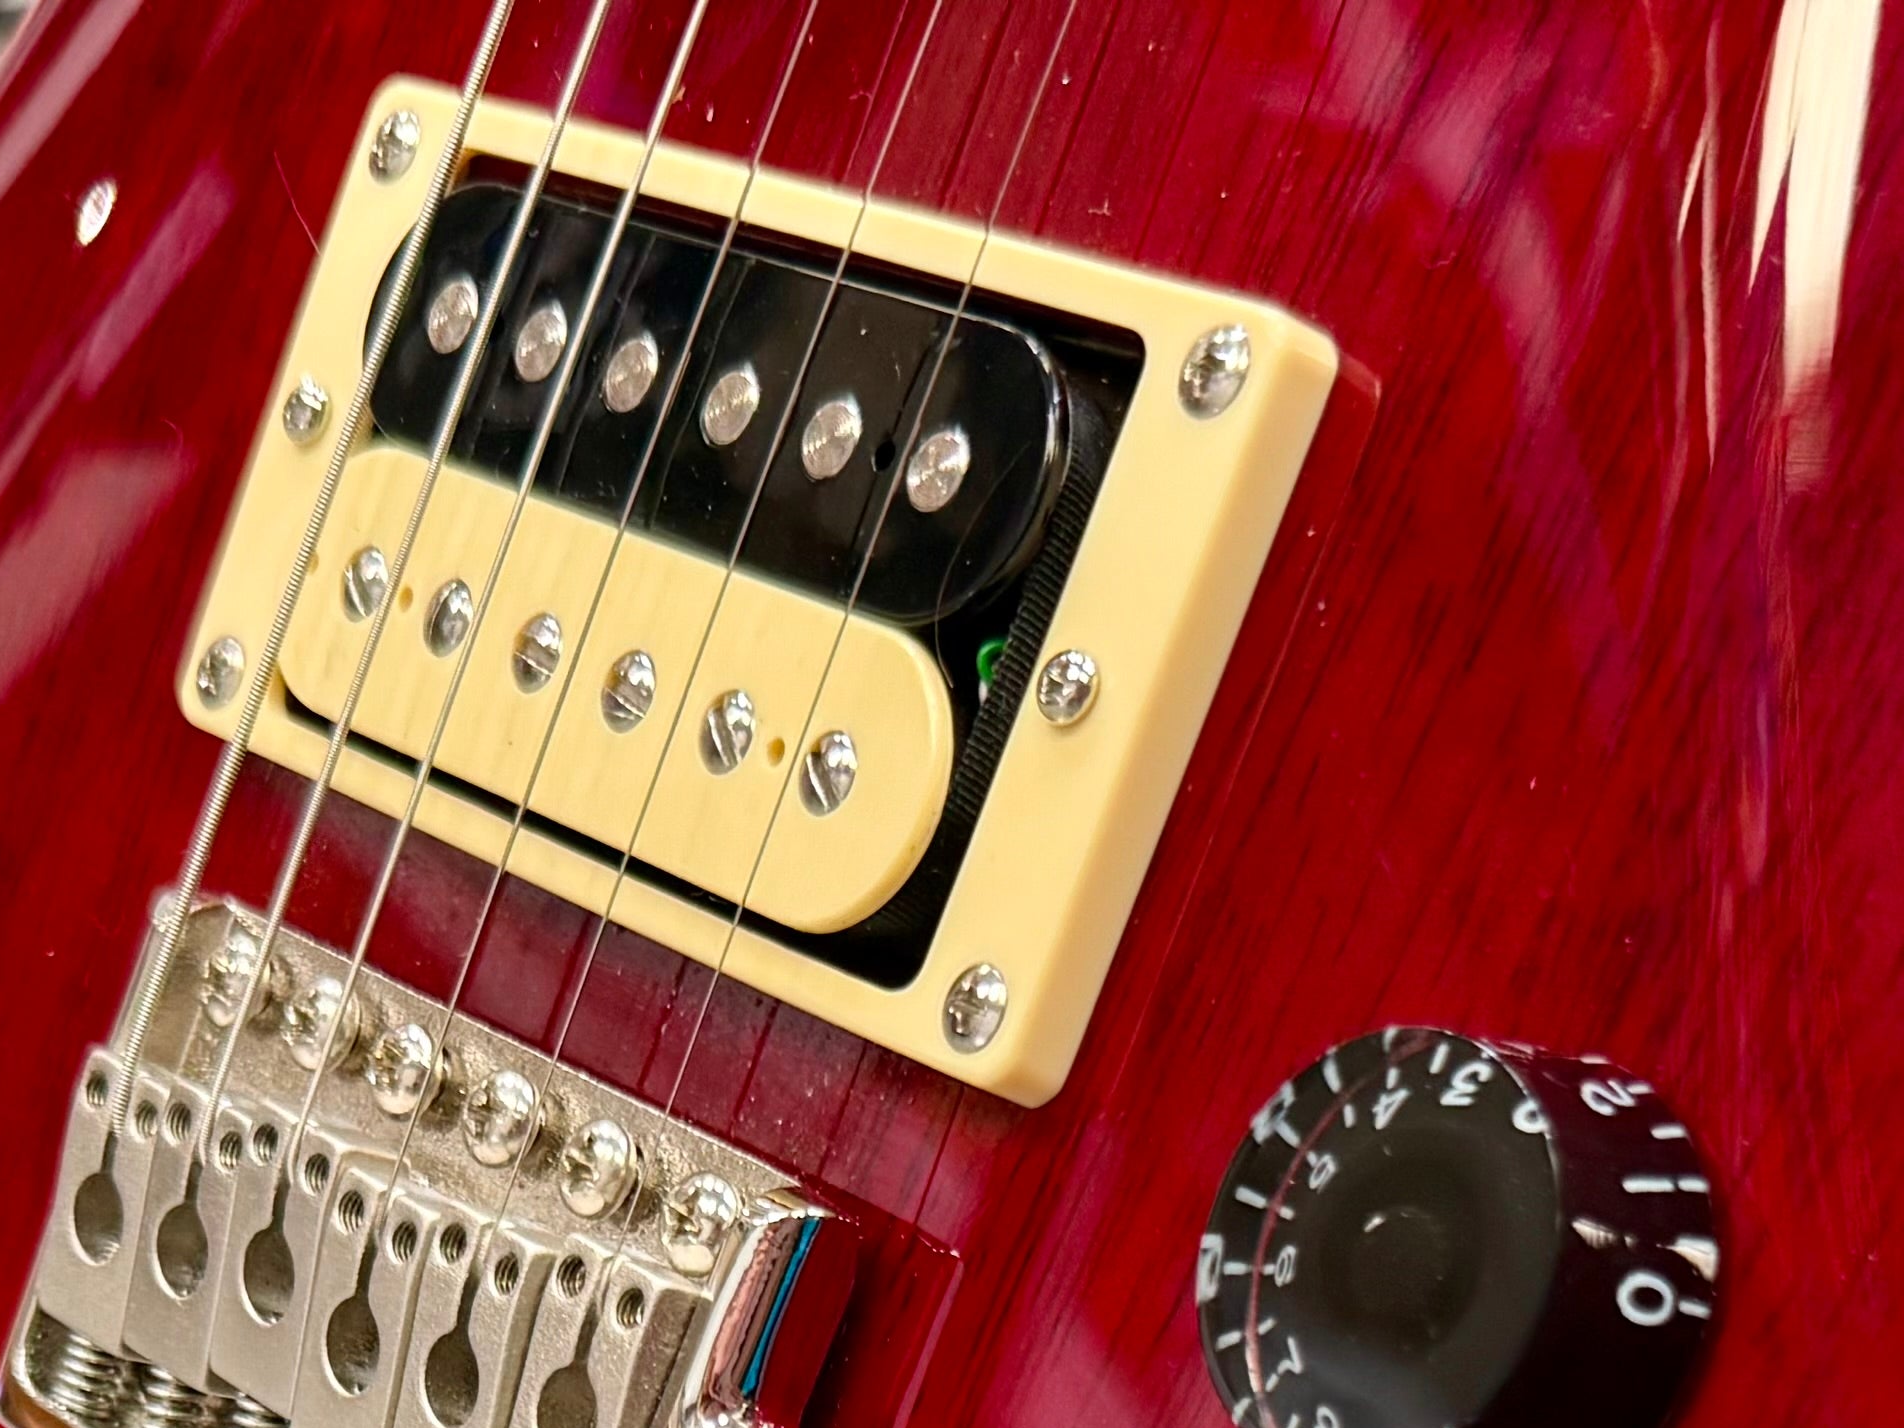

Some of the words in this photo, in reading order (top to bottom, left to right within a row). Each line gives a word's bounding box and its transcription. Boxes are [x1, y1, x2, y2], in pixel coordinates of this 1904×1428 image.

[1439, 1060, 1494, 1107] 3
[1579, 1078, 1637, 1118] 2
[1371, 1087, 1411, 1131] 4
[1615, 1270, 1675, 1328] 0
